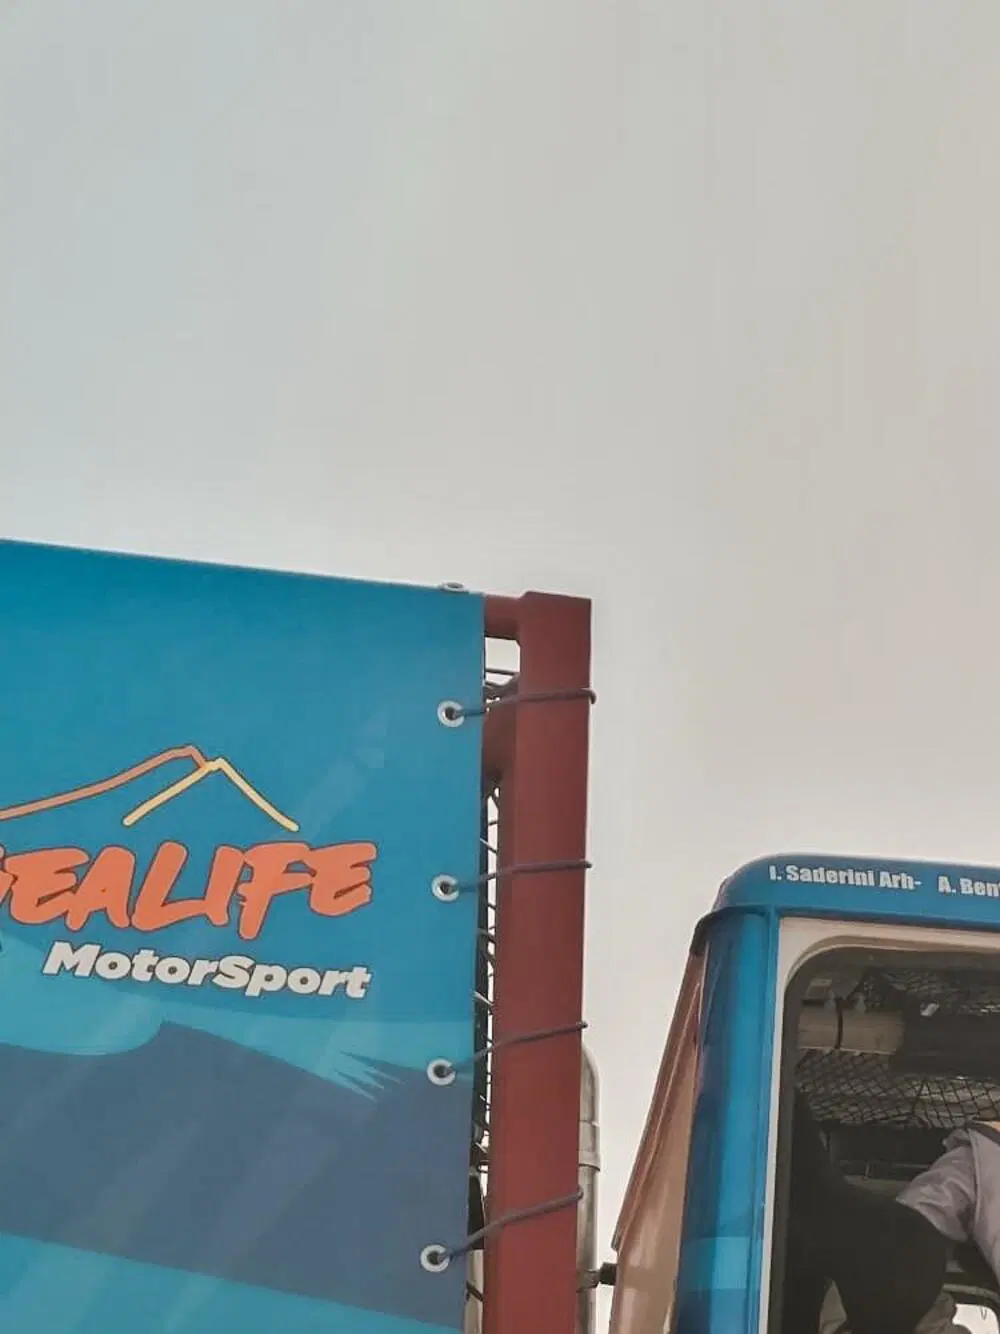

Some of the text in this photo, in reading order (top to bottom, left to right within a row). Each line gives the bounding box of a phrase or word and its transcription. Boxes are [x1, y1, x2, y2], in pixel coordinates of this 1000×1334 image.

[0, 842, 377, 939] EALIFE
[786, 865, 875, 887] Saderini
[938, 875, 956, 894] A.
[42, 941, 373, 999] MotorSport
